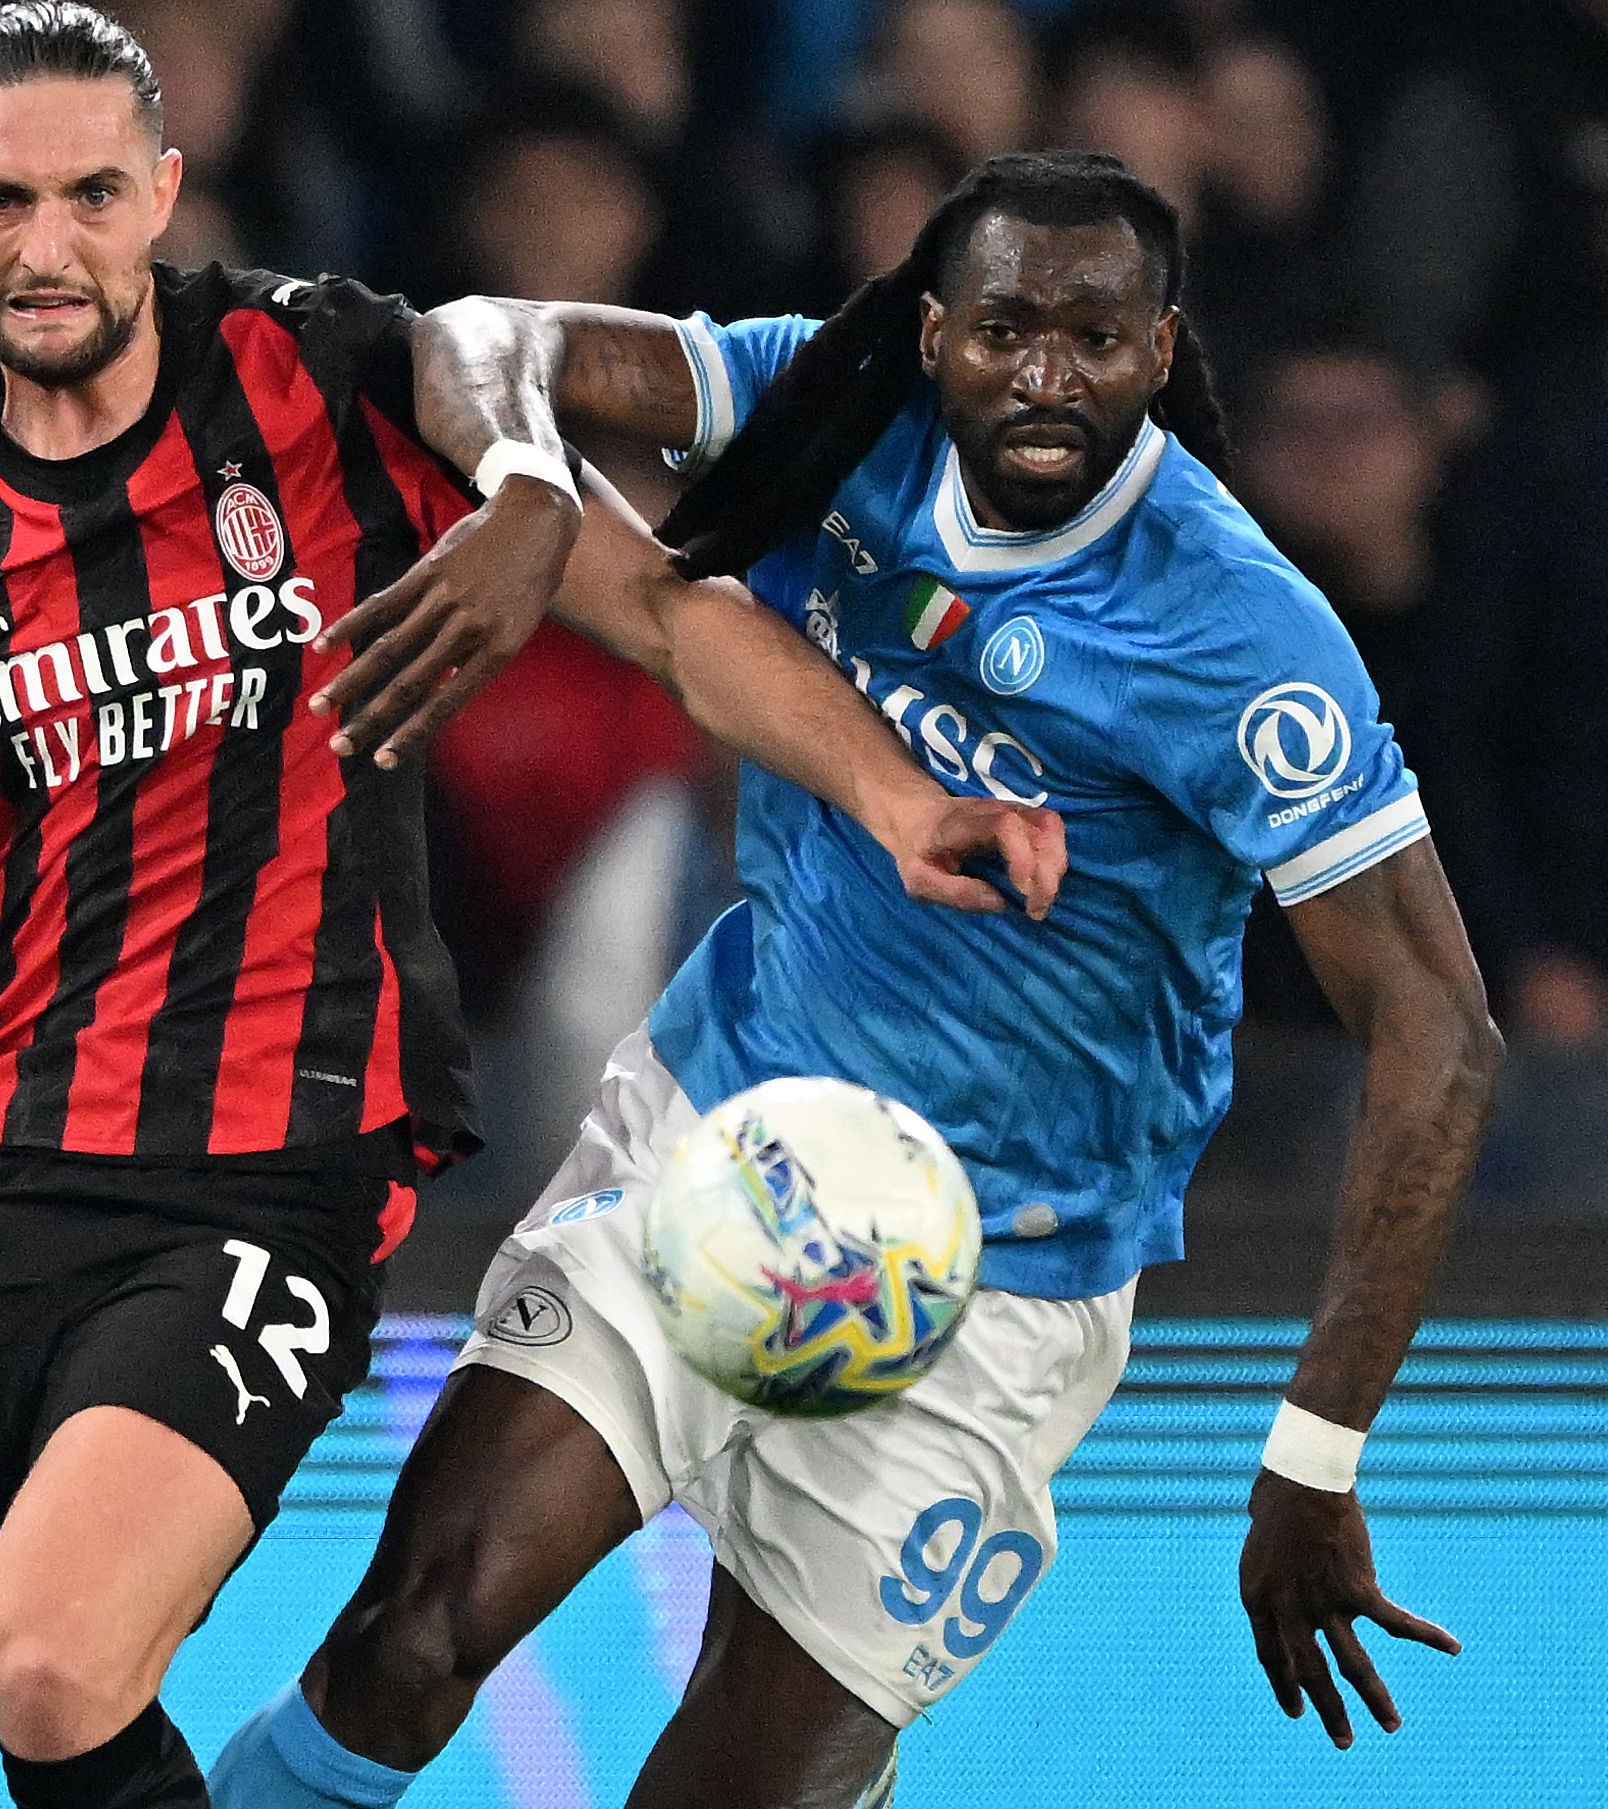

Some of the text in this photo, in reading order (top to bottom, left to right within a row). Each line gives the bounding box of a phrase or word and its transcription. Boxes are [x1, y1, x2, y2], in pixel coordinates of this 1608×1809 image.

[226, 491, 259, 516] ACM
[245, 556, 274, 571] 1899
[822, 511, 878, 574] EA7
[998, 636, 1031, 677] N
[10, 667, 268, 789] FLY BETTER
[222, 1239, 330, 1400] 12
[879, 1497, 1043, 1660] 99
[902, 1643, 955, 1692] EA7
